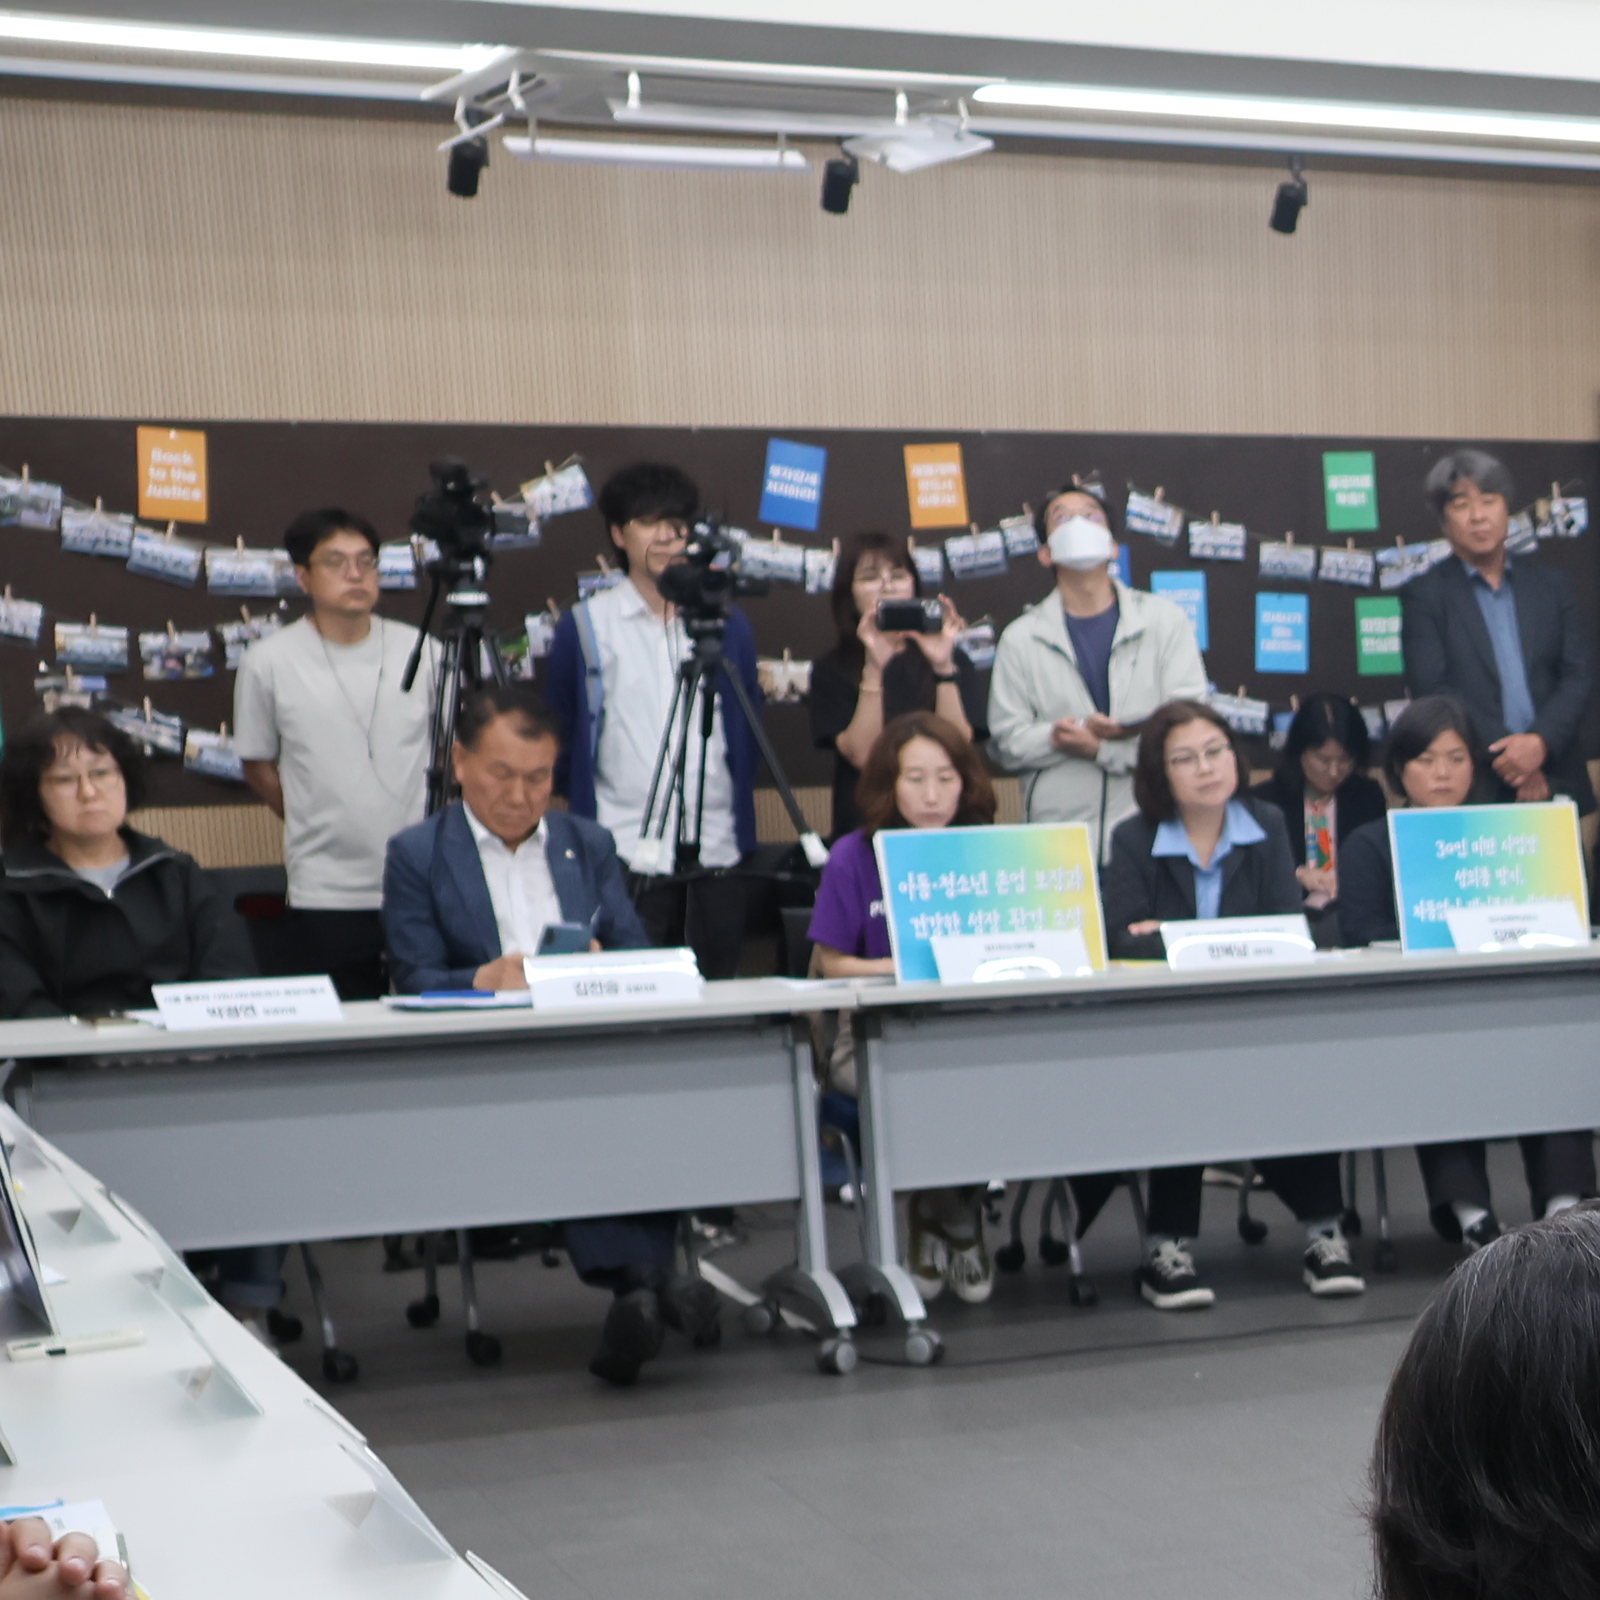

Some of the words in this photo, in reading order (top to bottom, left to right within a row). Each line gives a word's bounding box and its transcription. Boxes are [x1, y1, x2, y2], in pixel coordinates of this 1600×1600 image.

[151, 448, 194, 466] Back
[148, 465, 167, 482] to
[170, 467, 197, 484] the
[146, 484, 202, 501] Justice
